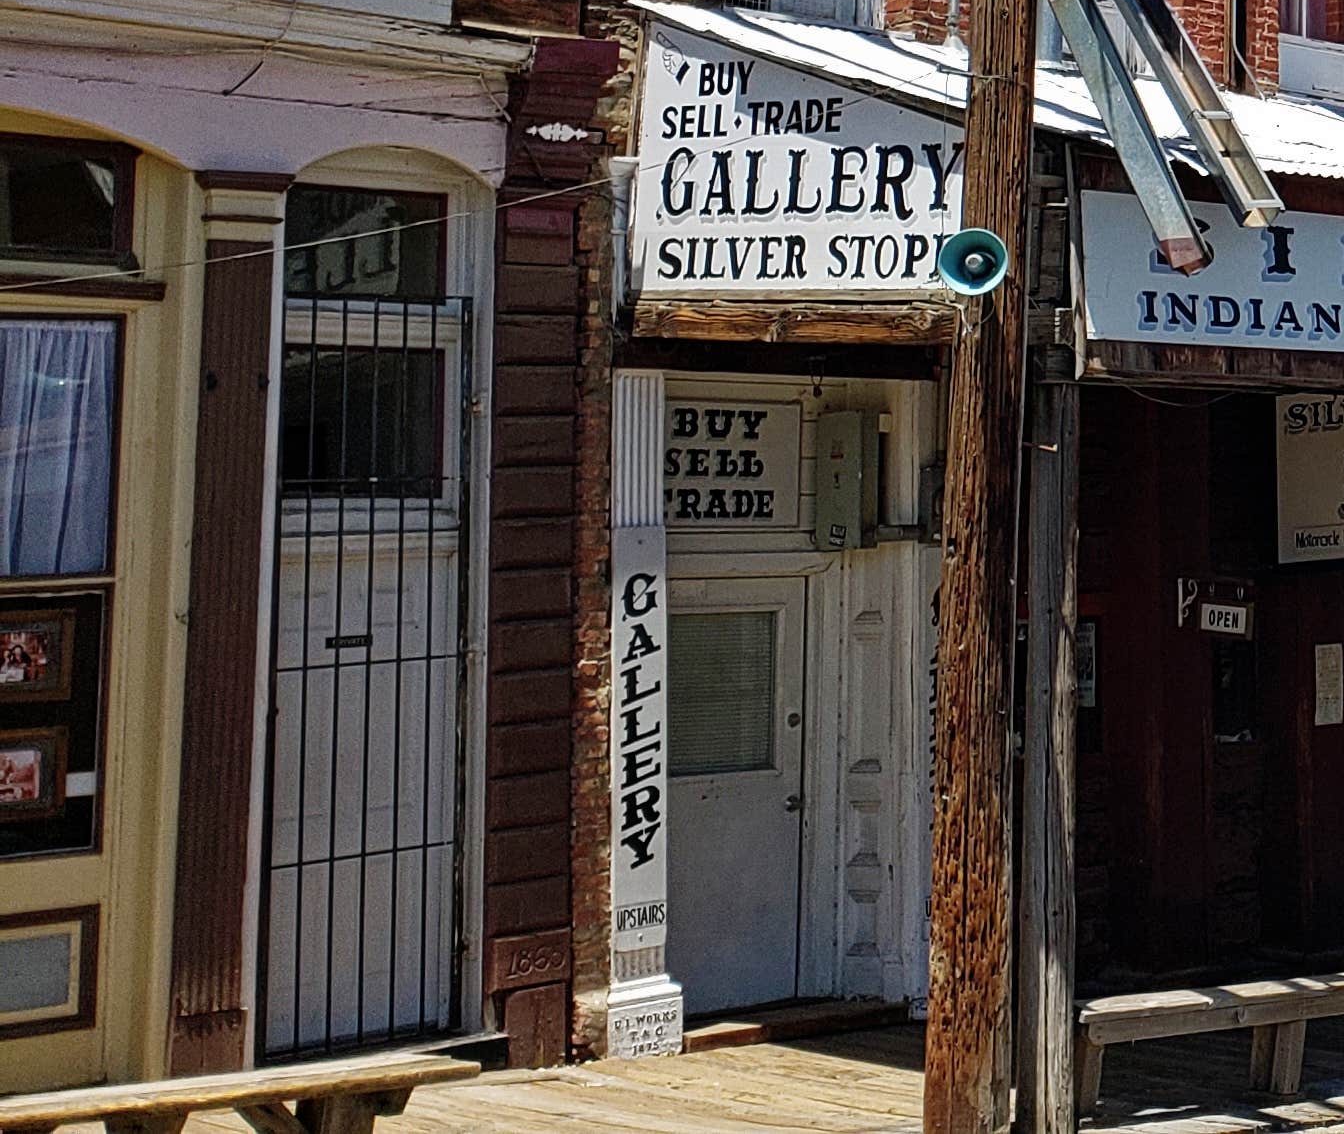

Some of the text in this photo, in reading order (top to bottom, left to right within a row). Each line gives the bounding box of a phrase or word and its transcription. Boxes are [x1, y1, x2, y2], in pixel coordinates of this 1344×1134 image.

[699, 60, 755, 97] BUY
[662, 97, 844, 139] SELL TRADE
[657, 142, 965, 221] GALLERY
[657, 235, 807, 281] SILVER
[1140, 290, 1342, 337] INDIAN
[673, 408, 768, 440] BUY
[664, 448, 764, 478] SELL
[1208, 609, 1239, 628] OPEN
[620, 572, 661, 869] GALLERY
[616, 903, 666, 931] UPSTAIRS
[636, 1009, 678, 1024] WORKS
